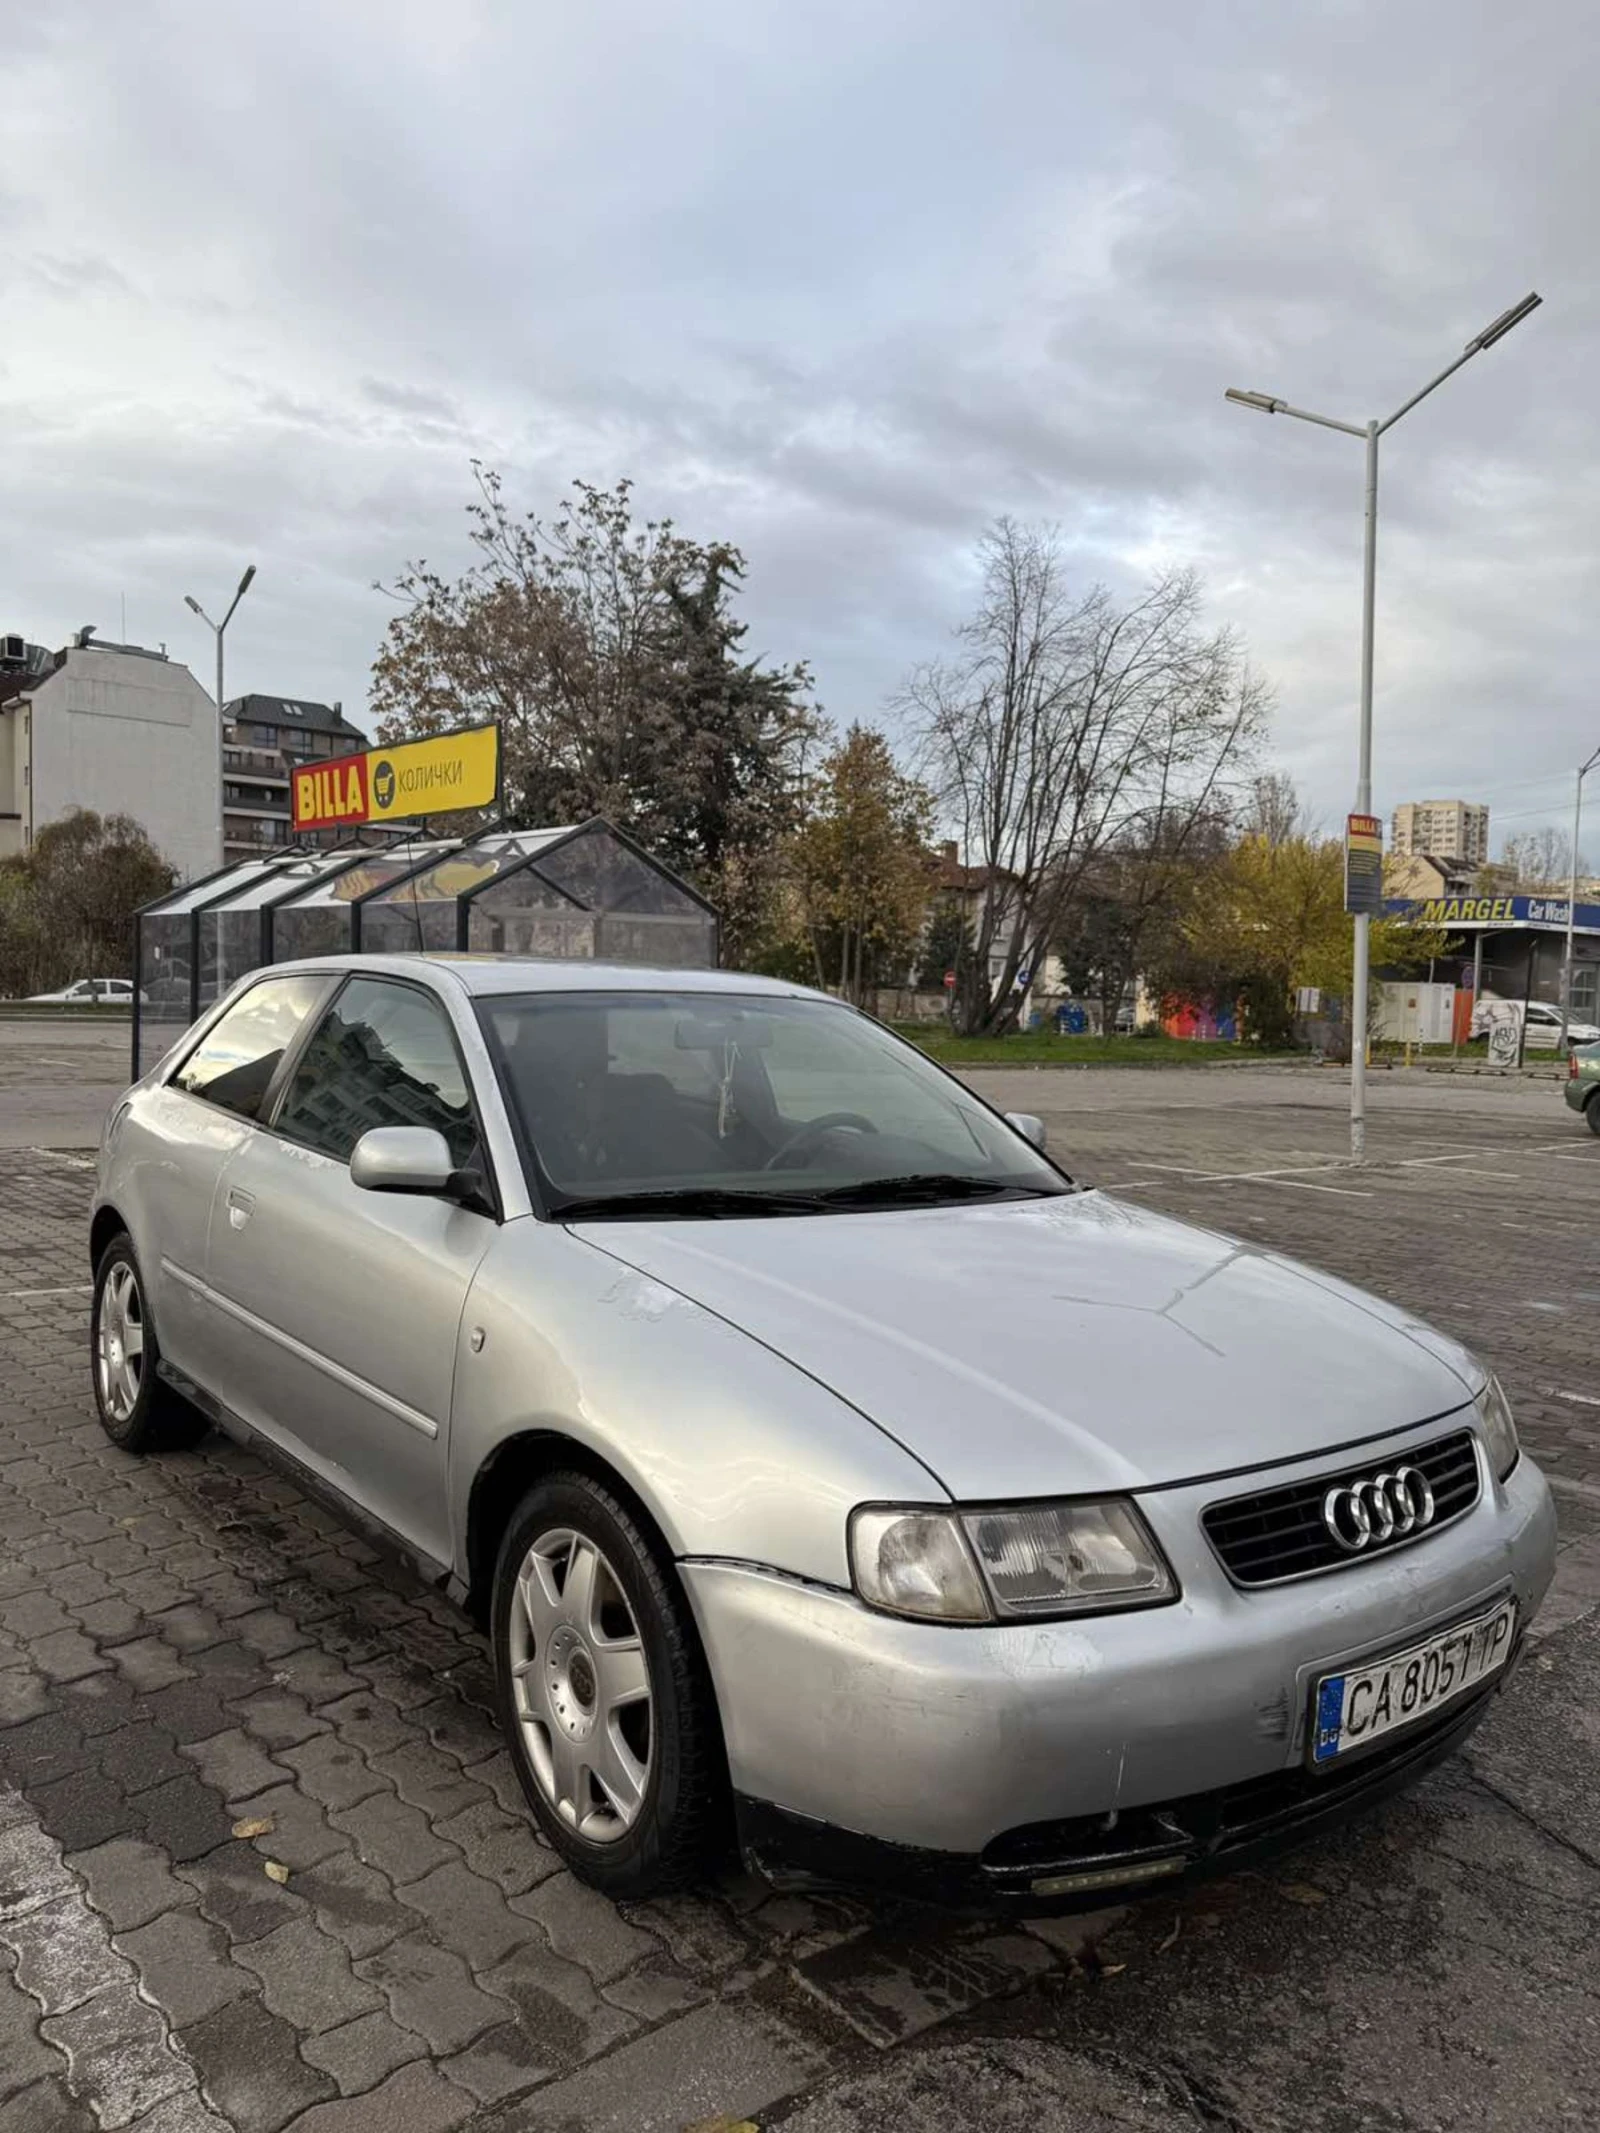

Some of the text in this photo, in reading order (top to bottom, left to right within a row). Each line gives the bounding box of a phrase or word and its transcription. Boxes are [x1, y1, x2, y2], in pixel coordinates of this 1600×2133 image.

[297, 766, 363, 820] BILLA
[399, 760, 462, 793] КОЛИЧКИ
[1425, 899, 1515, 920] MARGEL
[1528, 900, 1544, 919] Car
[1348, 1671, 1391, 1736] CA
[1479, 1612, 1509, 1671] TP
